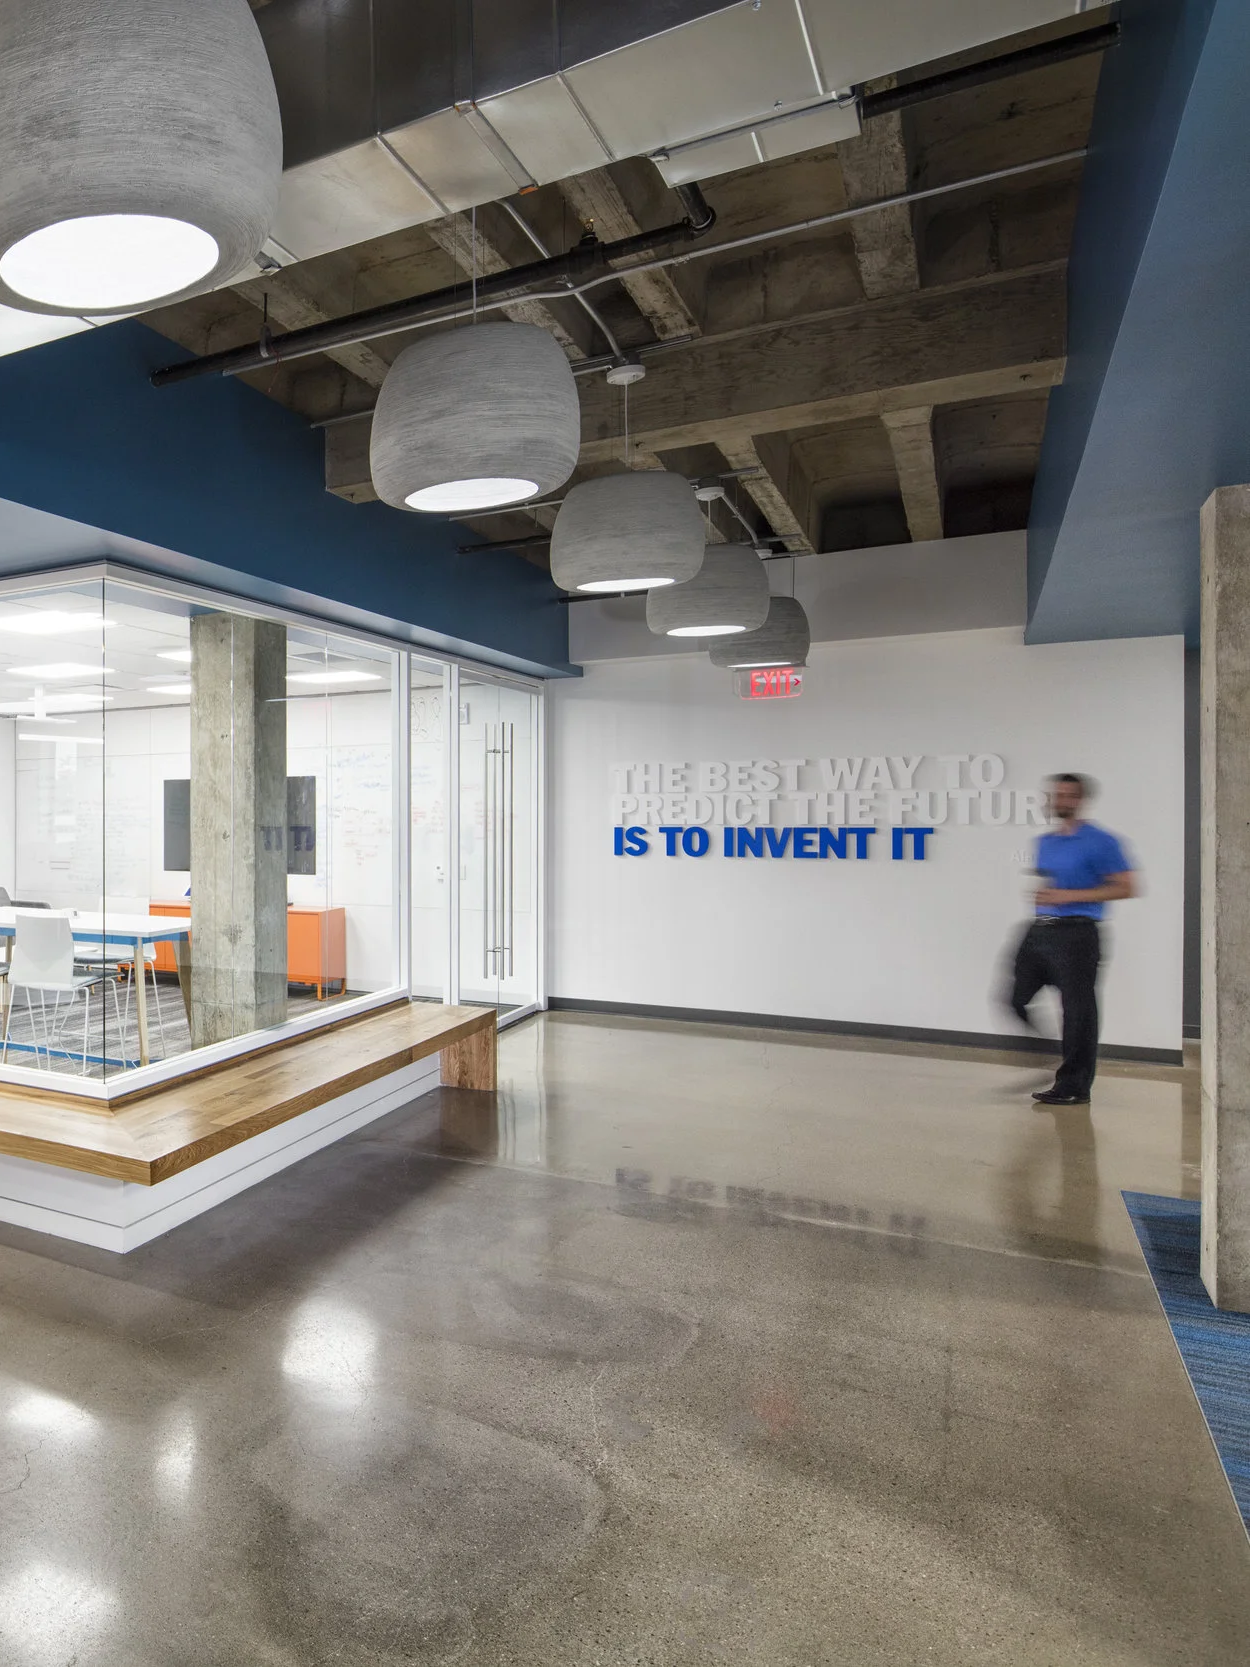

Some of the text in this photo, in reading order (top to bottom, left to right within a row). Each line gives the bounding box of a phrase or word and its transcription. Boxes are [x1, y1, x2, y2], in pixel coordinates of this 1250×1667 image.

[751, 669, 794, 697] EXIT
[612, 753, 1006, 794] THE BEST WAY TO
[612, 793, 782, 826] PREDICT
[788, 791, 878, 826] THE
[614, 826, 934, 861] IS TO INVENT IT
